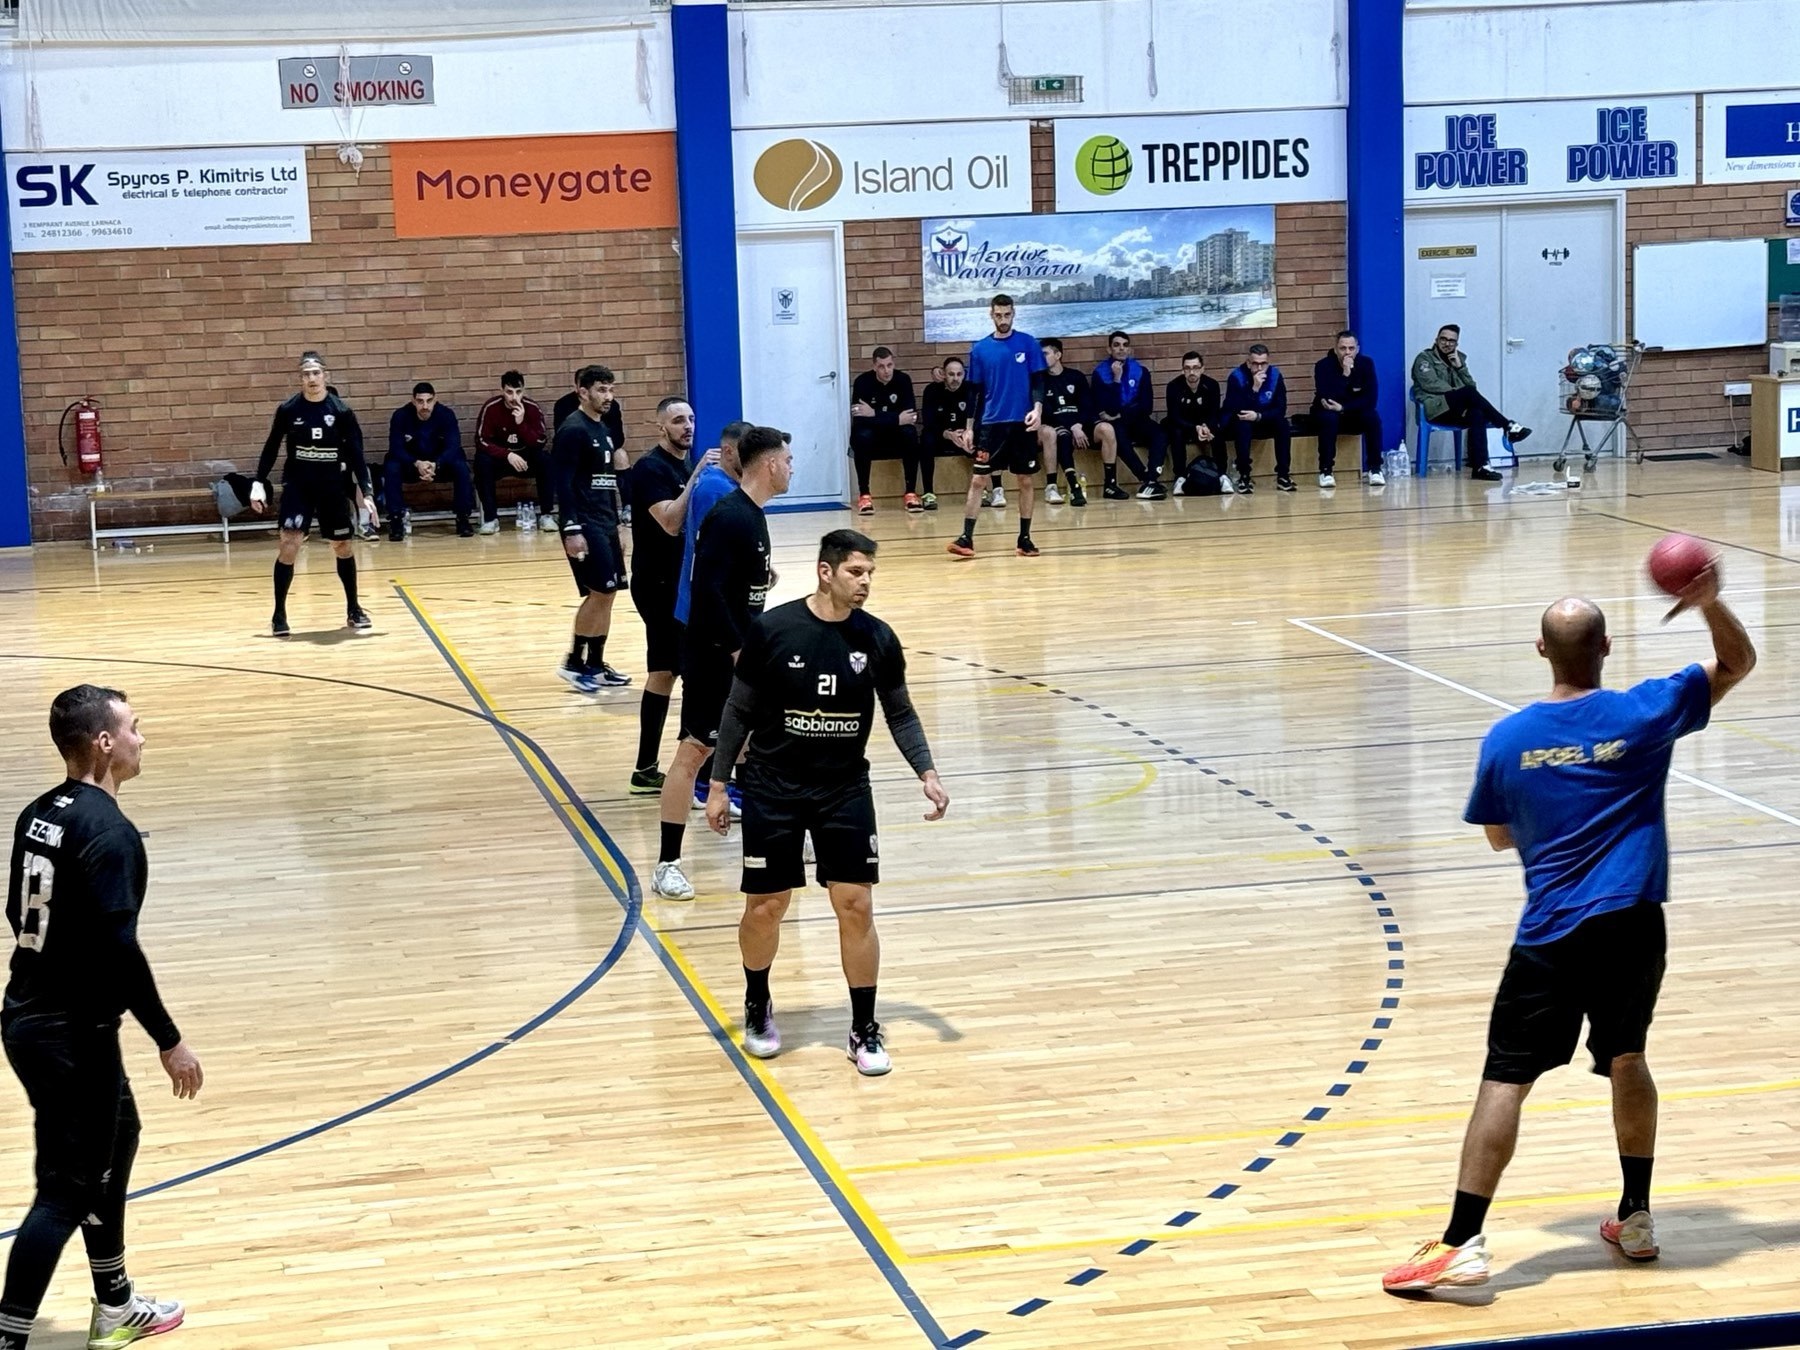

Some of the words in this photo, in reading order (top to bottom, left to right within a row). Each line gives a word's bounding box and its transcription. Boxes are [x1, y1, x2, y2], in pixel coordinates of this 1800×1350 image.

[290, 83, 319, 104] NO
[333, 79, 425, 103] SMOKING
[1445, 114, 1497, 151] ICE
[1597, 106, 1648, 145] ICE
[107, 171, 170, 189] Spyros
[177, 170, 193, 184] P.
[200, 168, 264, 184] Kimitris
[271, 167, 297, 181] Ltd
[854, 157, 953, 195] Island
[967, 155, 1008, 190] Oil
[1142, 138, 1310, 184] TREPPIDES
[1415, 149, 1528, 190] POWER
[1566, 140, 1679, 182] POWER
[1746, 159, 1795, 171] dimensions
[16, 164, 99, 207] SK
[122, 189, 168, 199] electrical
[172, 189, 180, 198] &
[184, 188, 231, 199] telephone
[235, 186, 288, 197] contractor
[417, 163, 652, 204] Moneygate
[817, 673, 837, 696] 21
[784, 716, 860, 732] sabbianco
